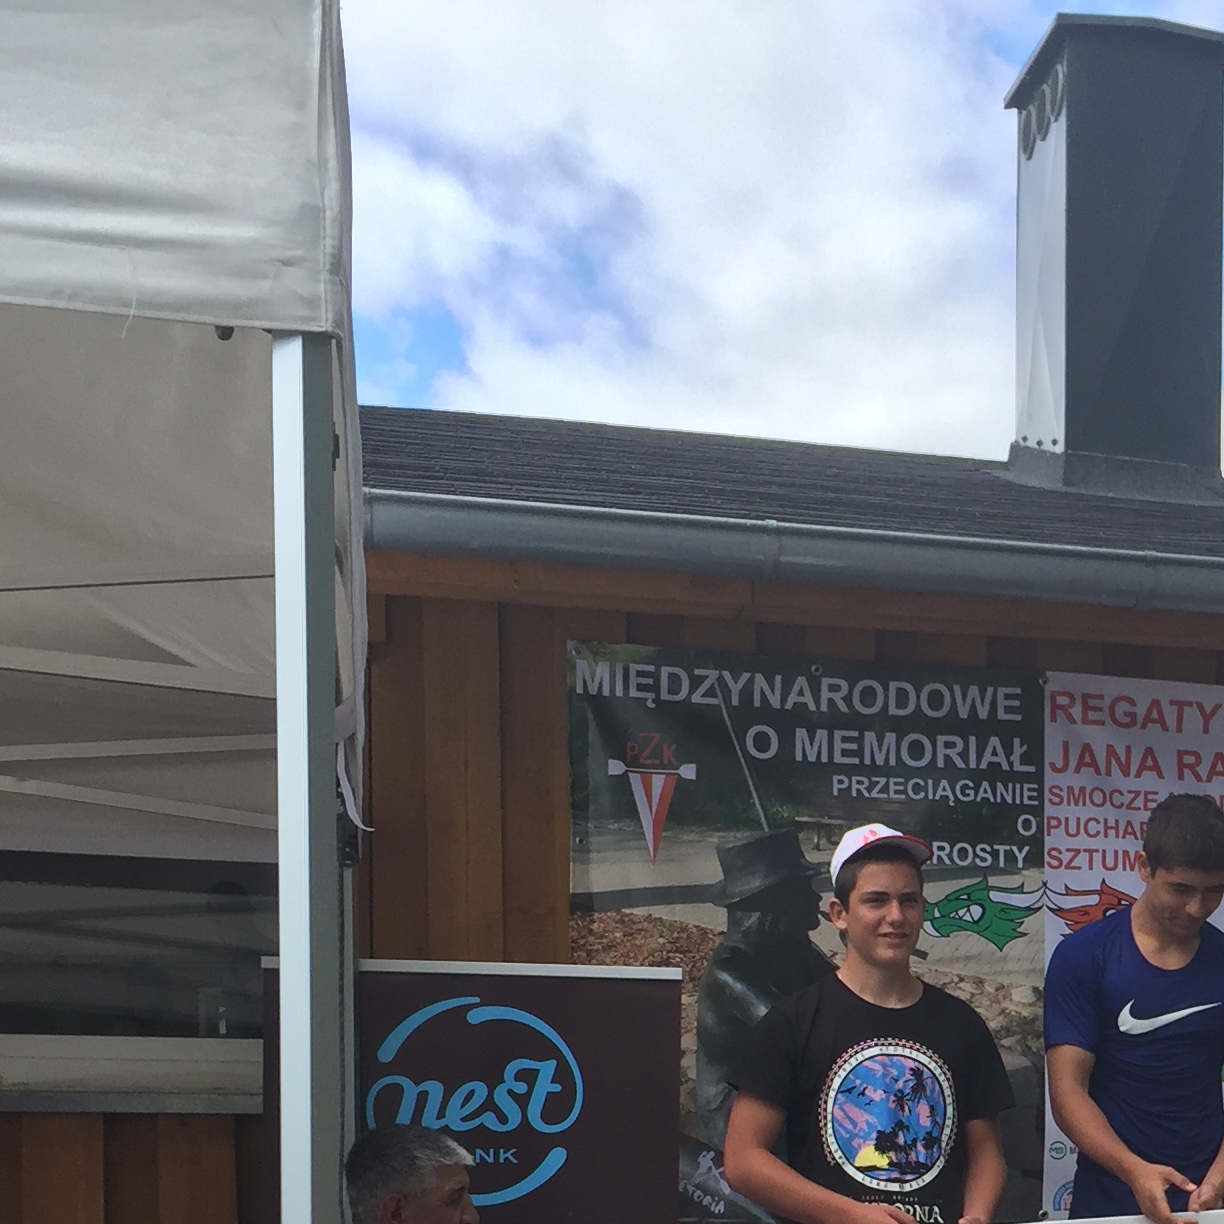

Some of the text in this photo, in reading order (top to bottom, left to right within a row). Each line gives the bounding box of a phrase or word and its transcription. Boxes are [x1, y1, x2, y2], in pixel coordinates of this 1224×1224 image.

[575, 659, 1023, 720] MIĘDZYNARODOWE
[1049, 691, 1223, 735] REGATY
[626, 732, 678, 766] PZK
[745, 724, 1037, 773] O MEMORIAŁ
[1048, 740, 1165, 780] JANA
[832, 774, 1039, 807] PRZECIĄGANIE
[1047, 785, 1159, 812] SMOCZE
[1016, 814, 1037, 836] O
[925, 841, 1030, 869] ROSTY
[474, 1148, 518, 1164] NK
